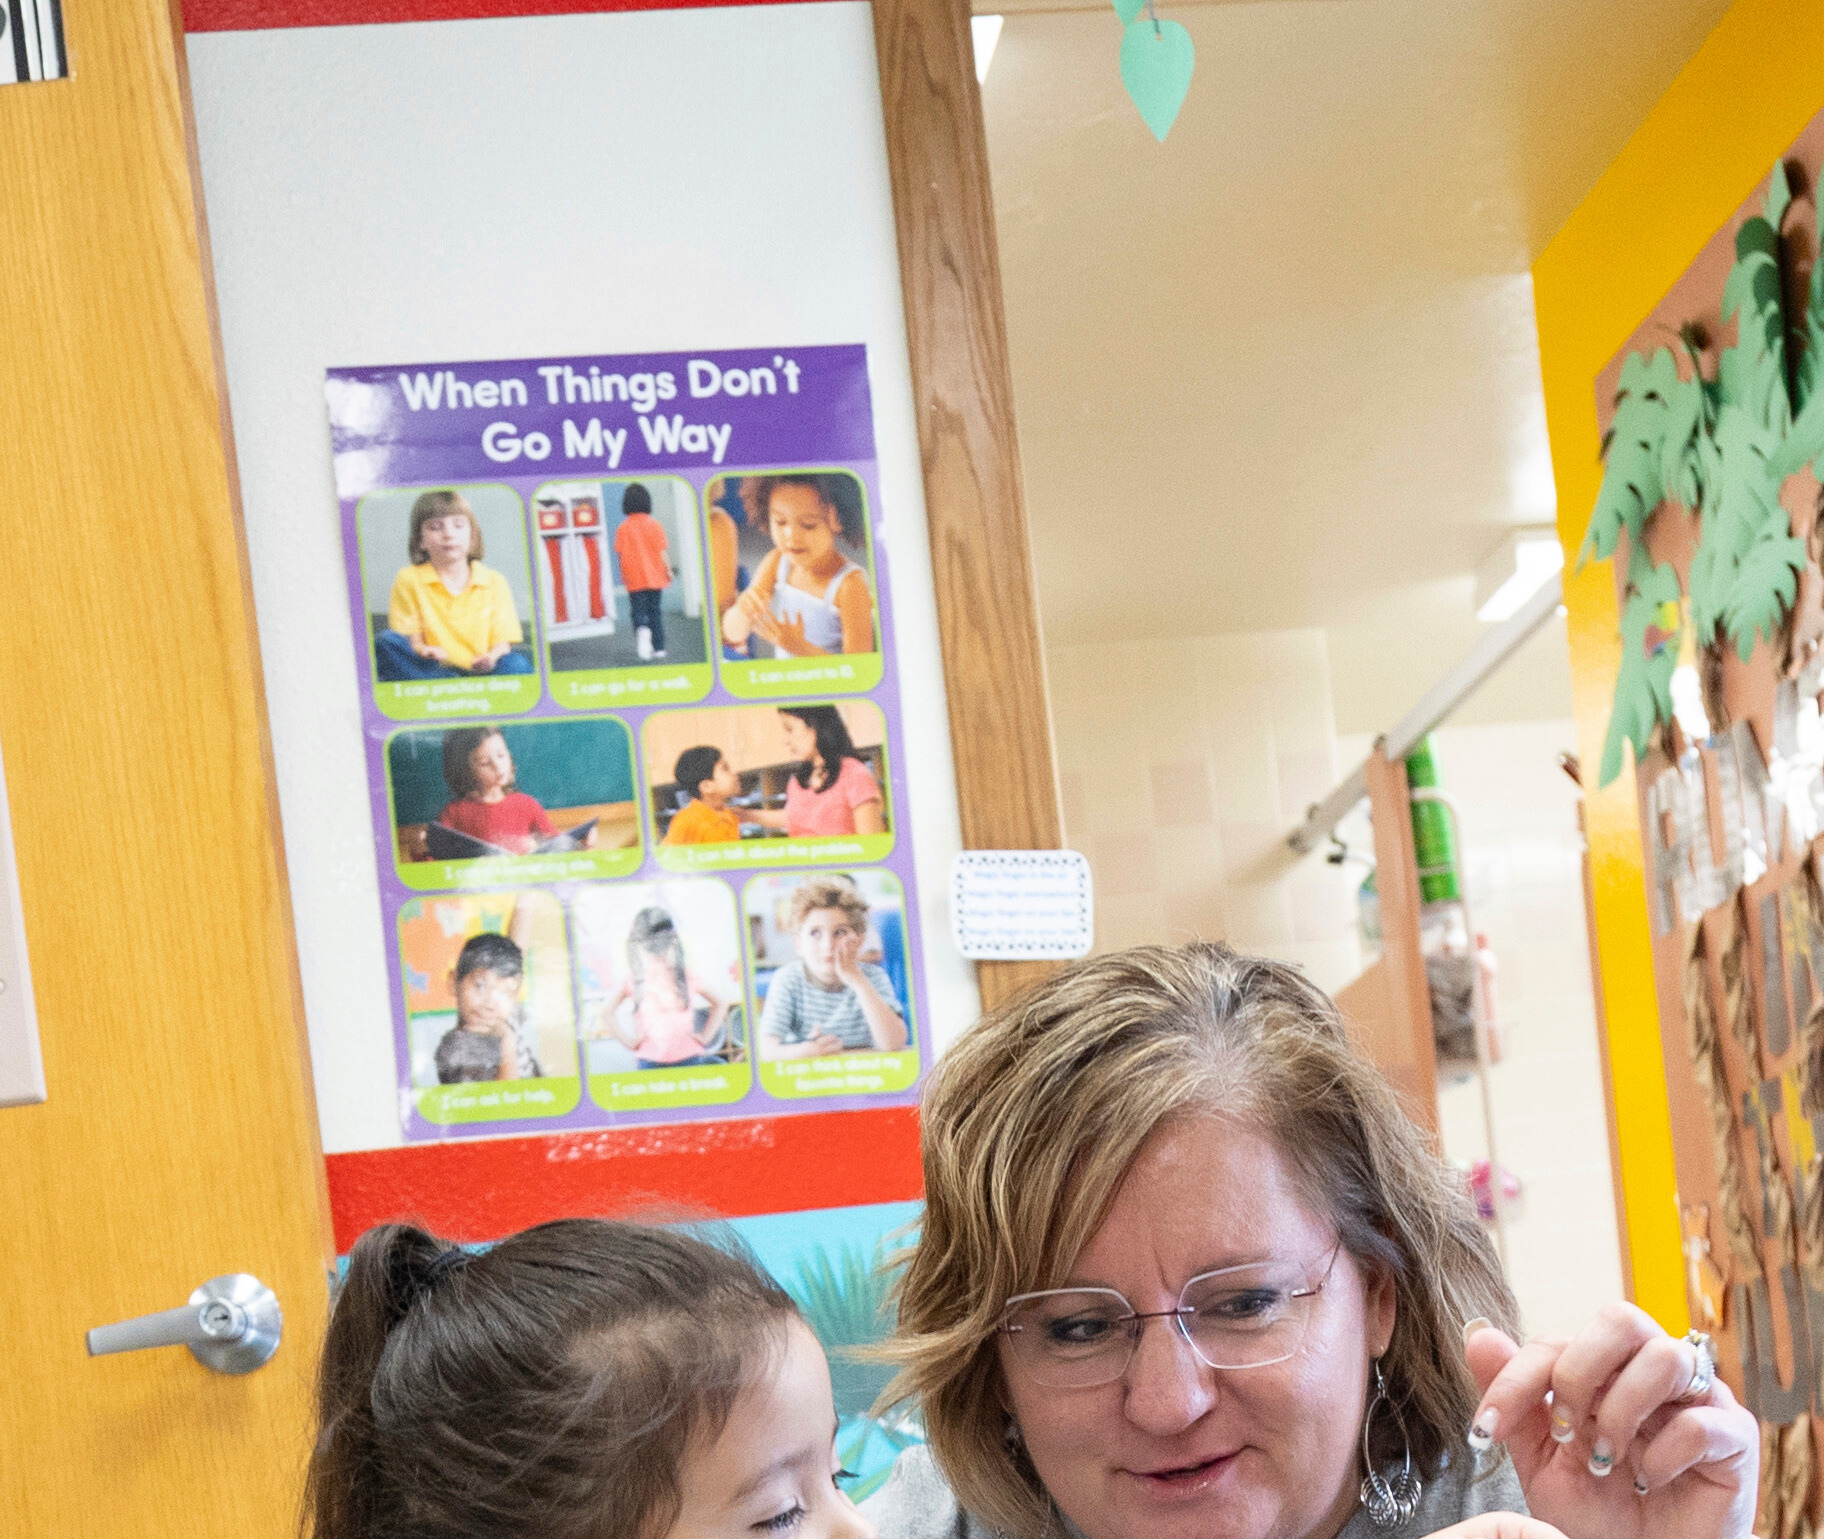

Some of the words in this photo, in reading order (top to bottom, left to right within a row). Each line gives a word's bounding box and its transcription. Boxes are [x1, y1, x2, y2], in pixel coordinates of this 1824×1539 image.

[399, 369, 528, 413] When
[537, 361, 677, 413] Things
[687, 354, 802, 400] Don't
[481, 421, 552, 464] Go
[562, 419, 628, 468] My
[638, 413, 733, 463] Way
